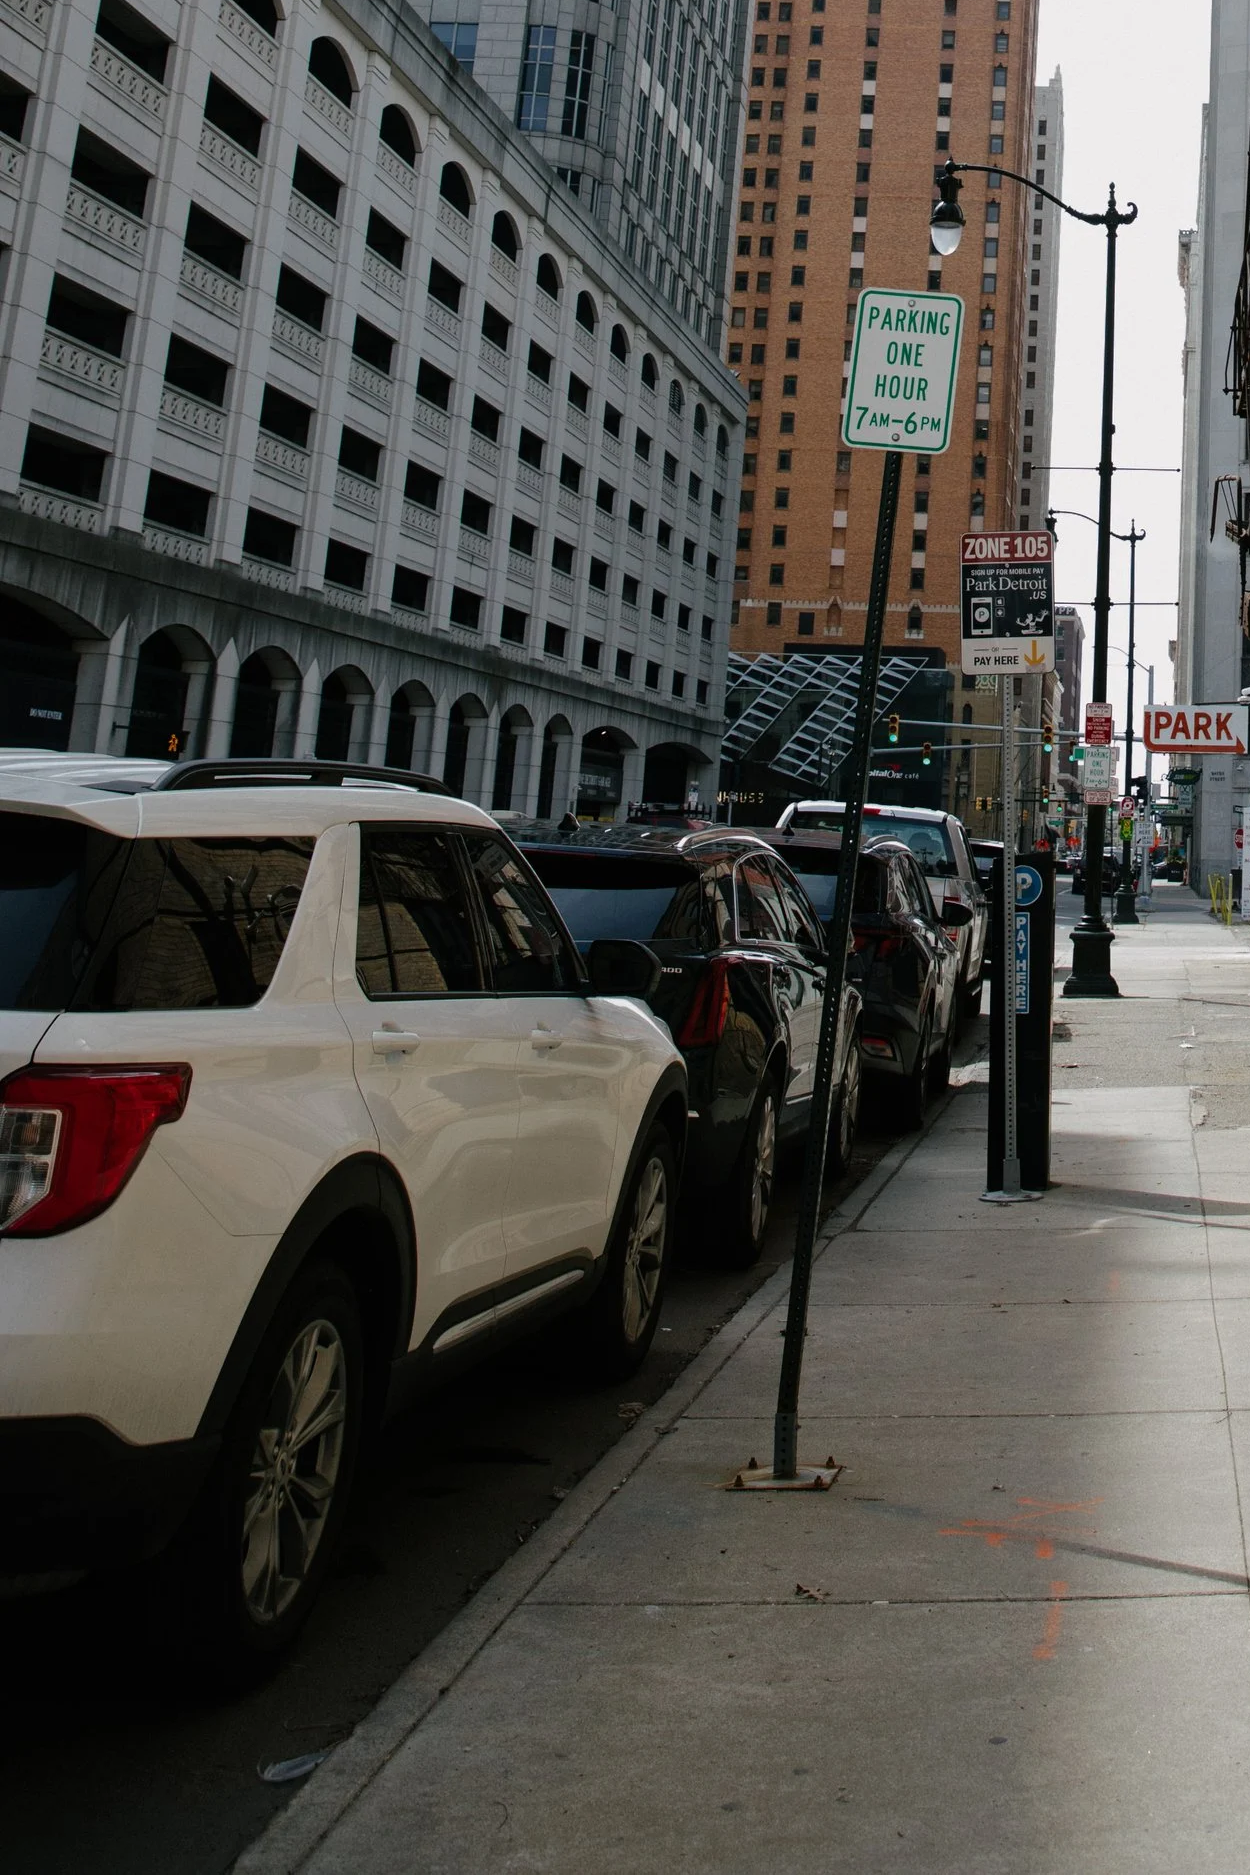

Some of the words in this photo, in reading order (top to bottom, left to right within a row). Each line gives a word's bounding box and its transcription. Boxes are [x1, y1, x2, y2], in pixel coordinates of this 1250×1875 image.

[868, 306, 951, 336] PARKING
[886, 341, 925, 367] ONE
[874, 374, 929, 401] HOUR
[964, 537, 1010, 559] ZONE
[1014, 536, 1049, 558] 105
[1029, 591, 1047, 600] .US
[974, 656, 992, 666] PAY
[994, 656, 1019, 666] HERE
[1154, 712, 1233, 741] PARK
[1087, 751, 1109, 759] PARKING
[1016, 873, 1033, 900] P
[1016, 916, 1026, 954] PAY
[1016, 959, 1026, 1009] HERE
